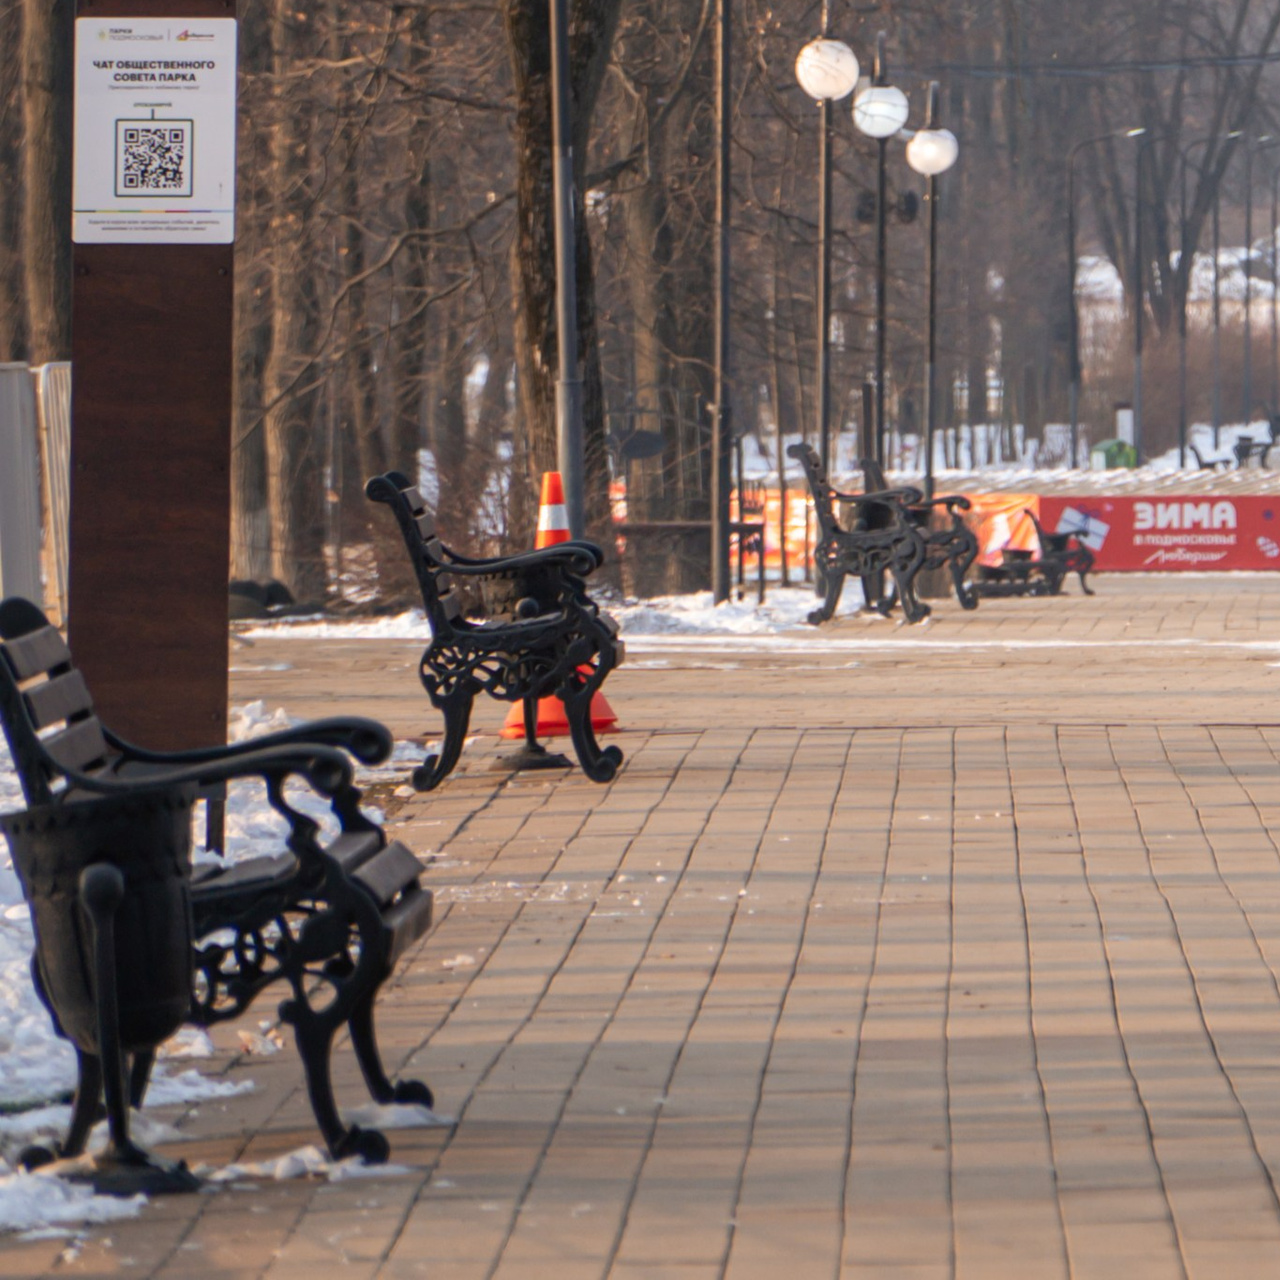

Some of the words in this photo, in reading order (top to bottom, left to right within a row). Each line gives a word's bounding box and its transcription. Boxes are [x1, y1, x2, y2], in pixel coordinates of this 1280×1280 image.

[93, 61, 114, 69] ЧАТ
[116, 61, 215, 70] ОБЩЕСТВЕННОГО
[113, 73, 156, 81] СОВЕТА
[159, 73, 196, 81] ПАРКА
[1133, 501, 1237, 529] ЗИМА
